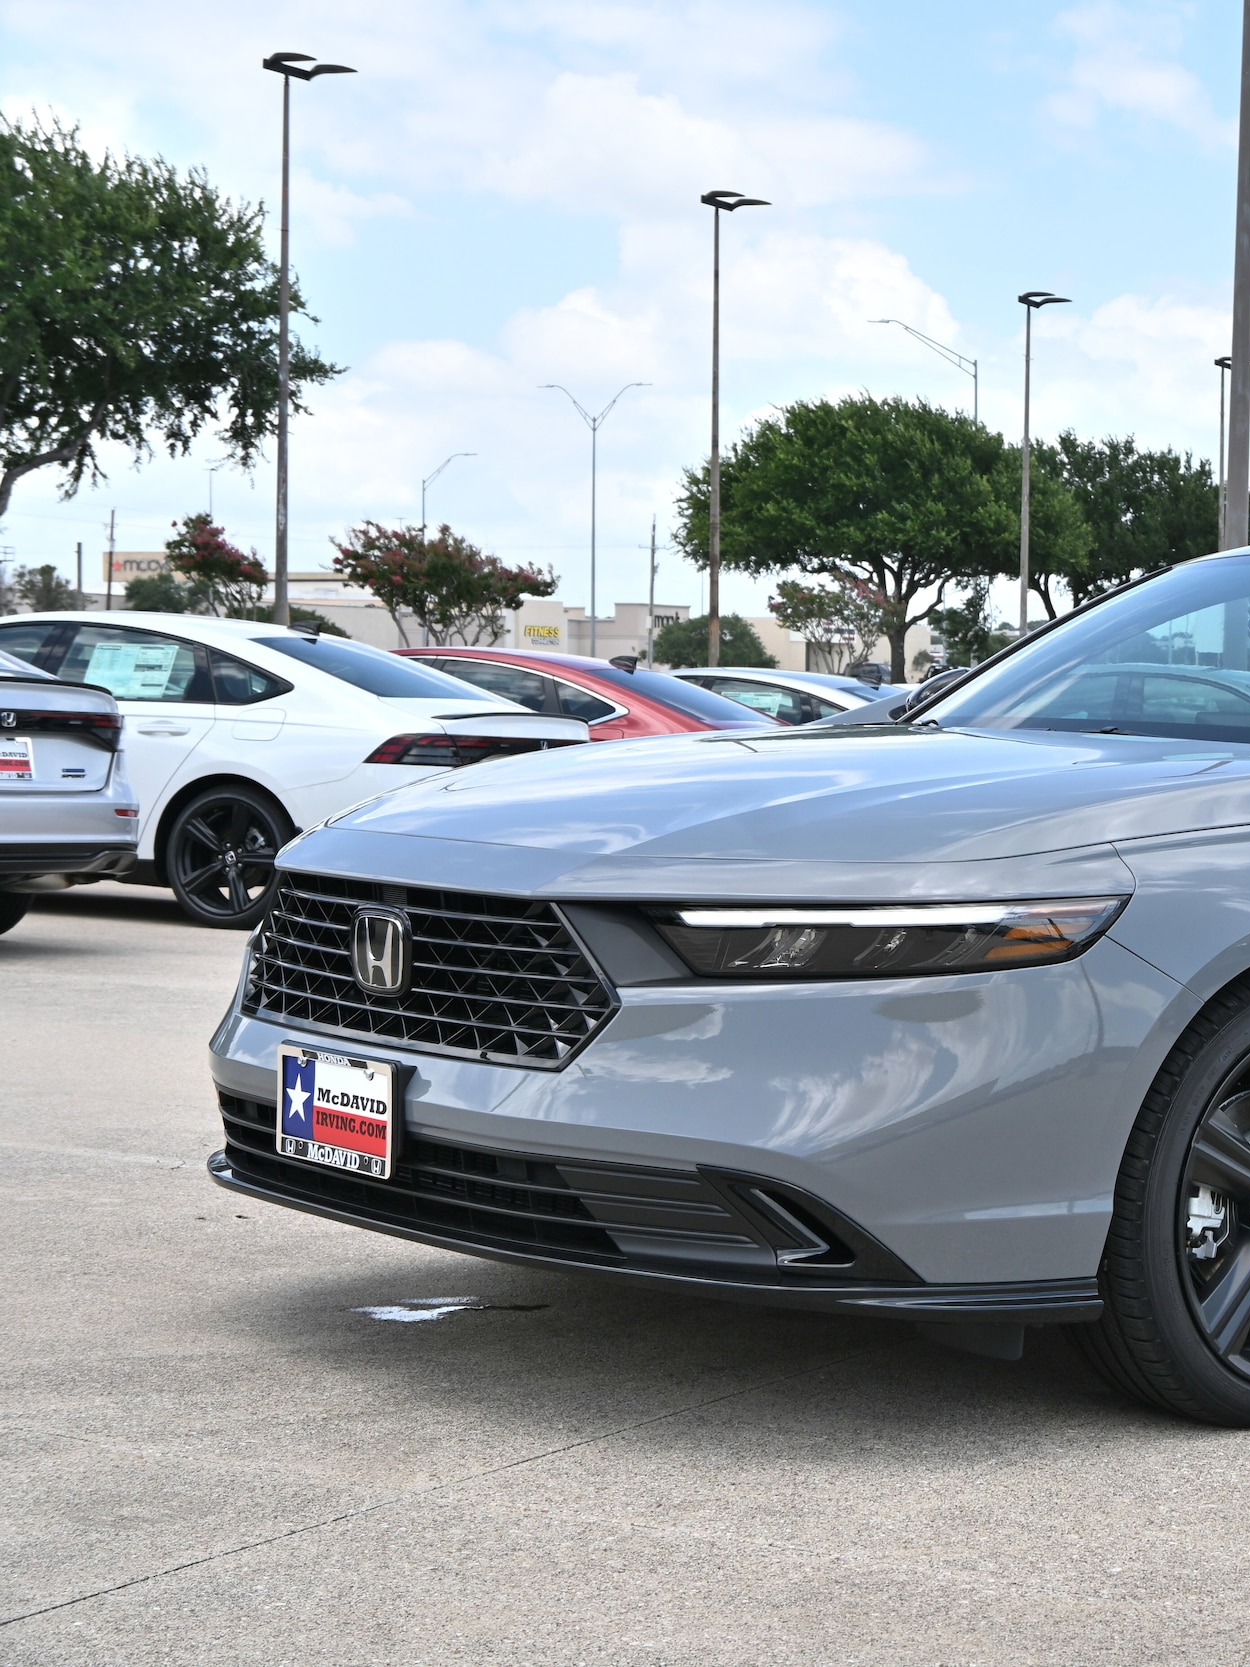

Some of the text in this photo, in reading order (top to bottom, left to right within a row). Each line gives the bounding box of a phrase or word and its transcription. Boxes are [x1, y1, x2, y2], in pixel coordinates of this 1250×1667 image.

[523, 625, 560, 638] FITNESS
[317, 1053, 352, 1067] HONDA
[317, 1087, 388, 1115] McDAVID
[315, 1110, 388, 1140] IRVING.COM
[306, 1142, 361, 1169] McDAVID
